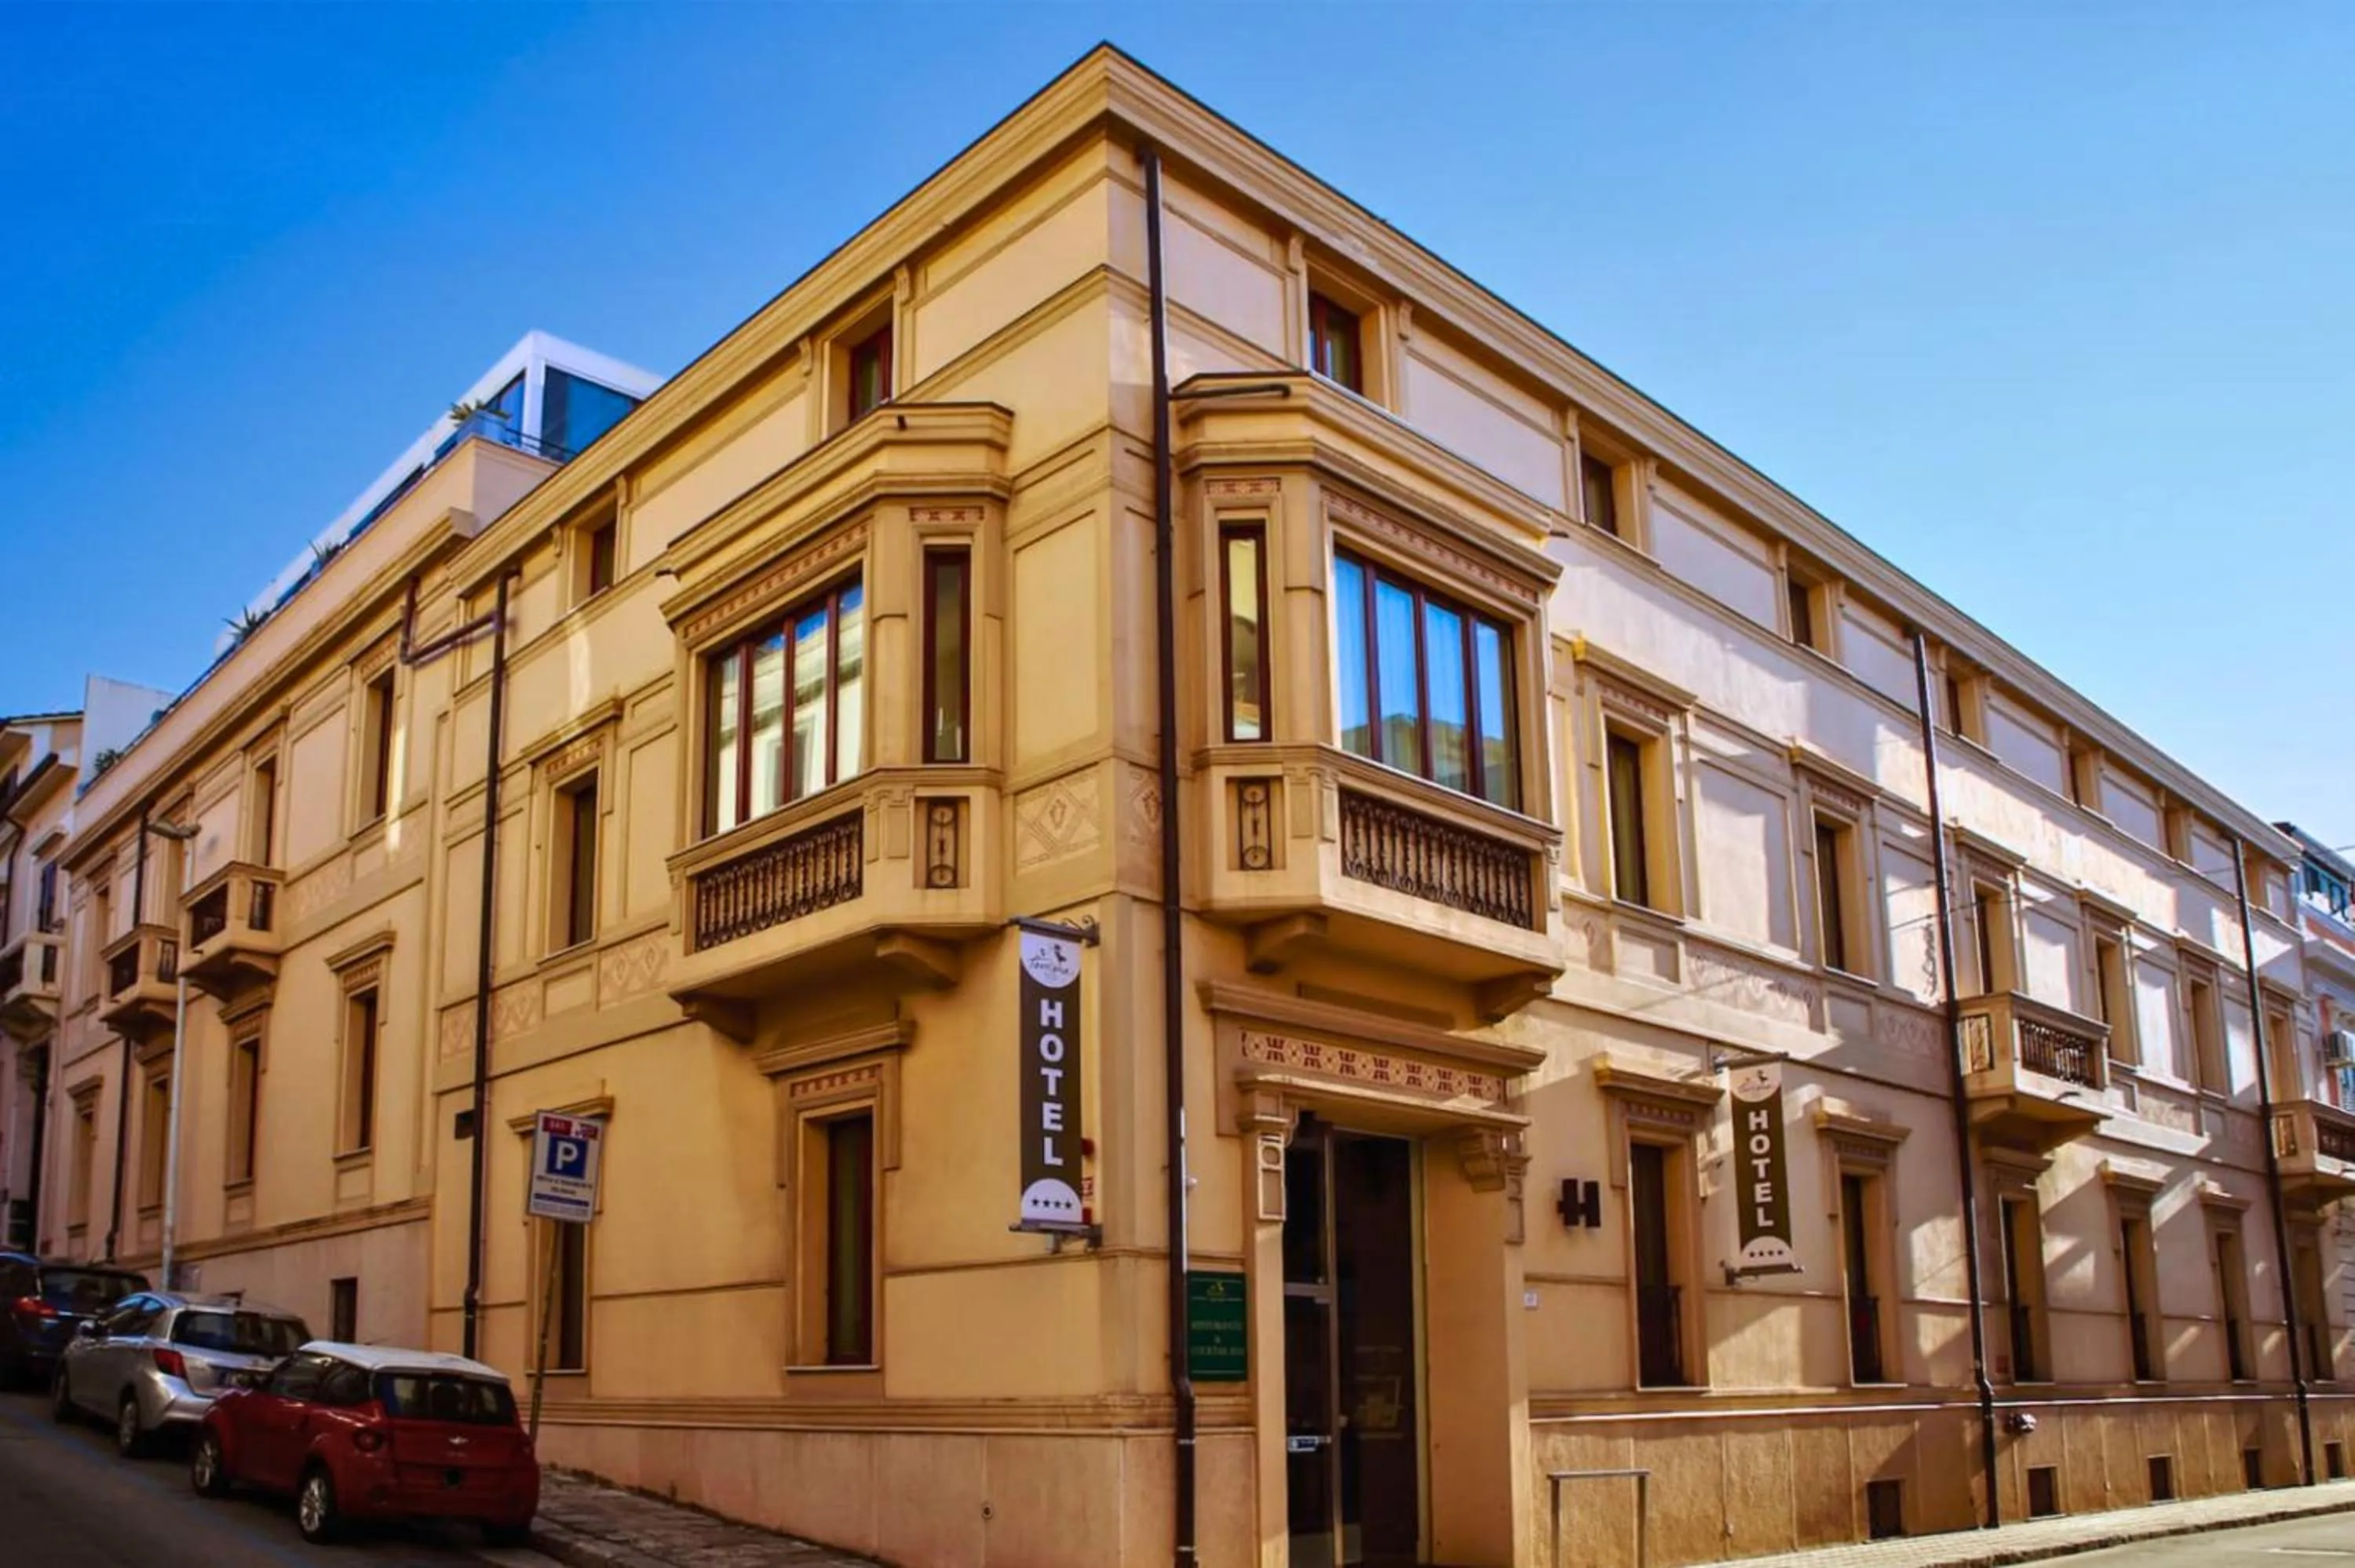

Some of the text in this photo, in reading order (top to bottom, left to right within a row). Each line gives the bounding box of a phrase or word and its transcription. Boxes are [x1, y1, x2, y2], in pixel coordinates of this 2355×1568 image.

[1039, 998, 1064, 1166] HOTEL
[555, 1140, 579, 1170] P
[1748, 1109, 1774, 1227] HOTEL
